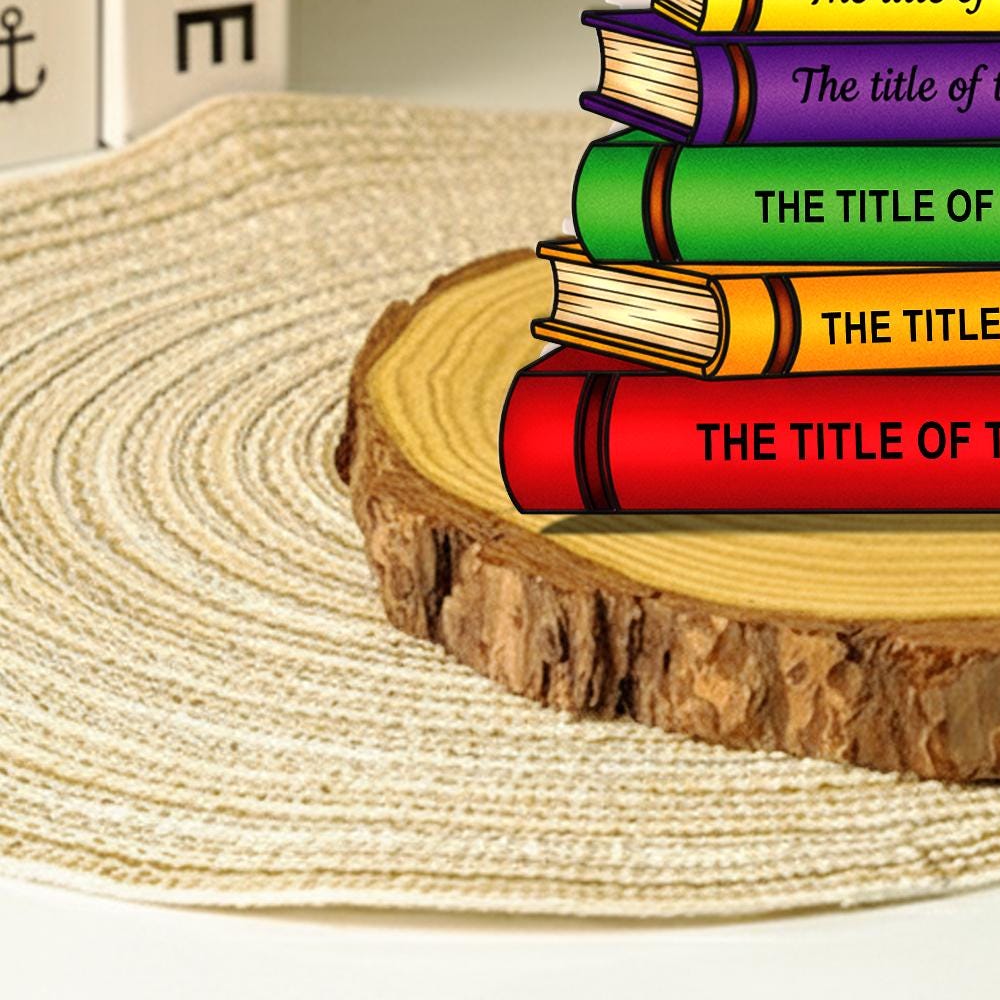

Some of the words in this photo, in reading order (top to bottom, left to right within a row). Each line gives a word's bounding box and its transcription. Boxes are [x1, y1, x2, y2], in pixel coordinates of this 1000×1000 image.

[792, 64, 860, 104] The
[871, 64, 938, 102] title
[948, 63, 988, 114] of
[754, 189, 825, 223] THE
[835, 189, 935, 223] TITLE
[946, 188, 994, 223] OF
[821, 310, 892, 345] THE
[696, 423, 777, 461] THE
[789, 421, 903, 460] TITLE
[917, 421, 971, 459] OF
